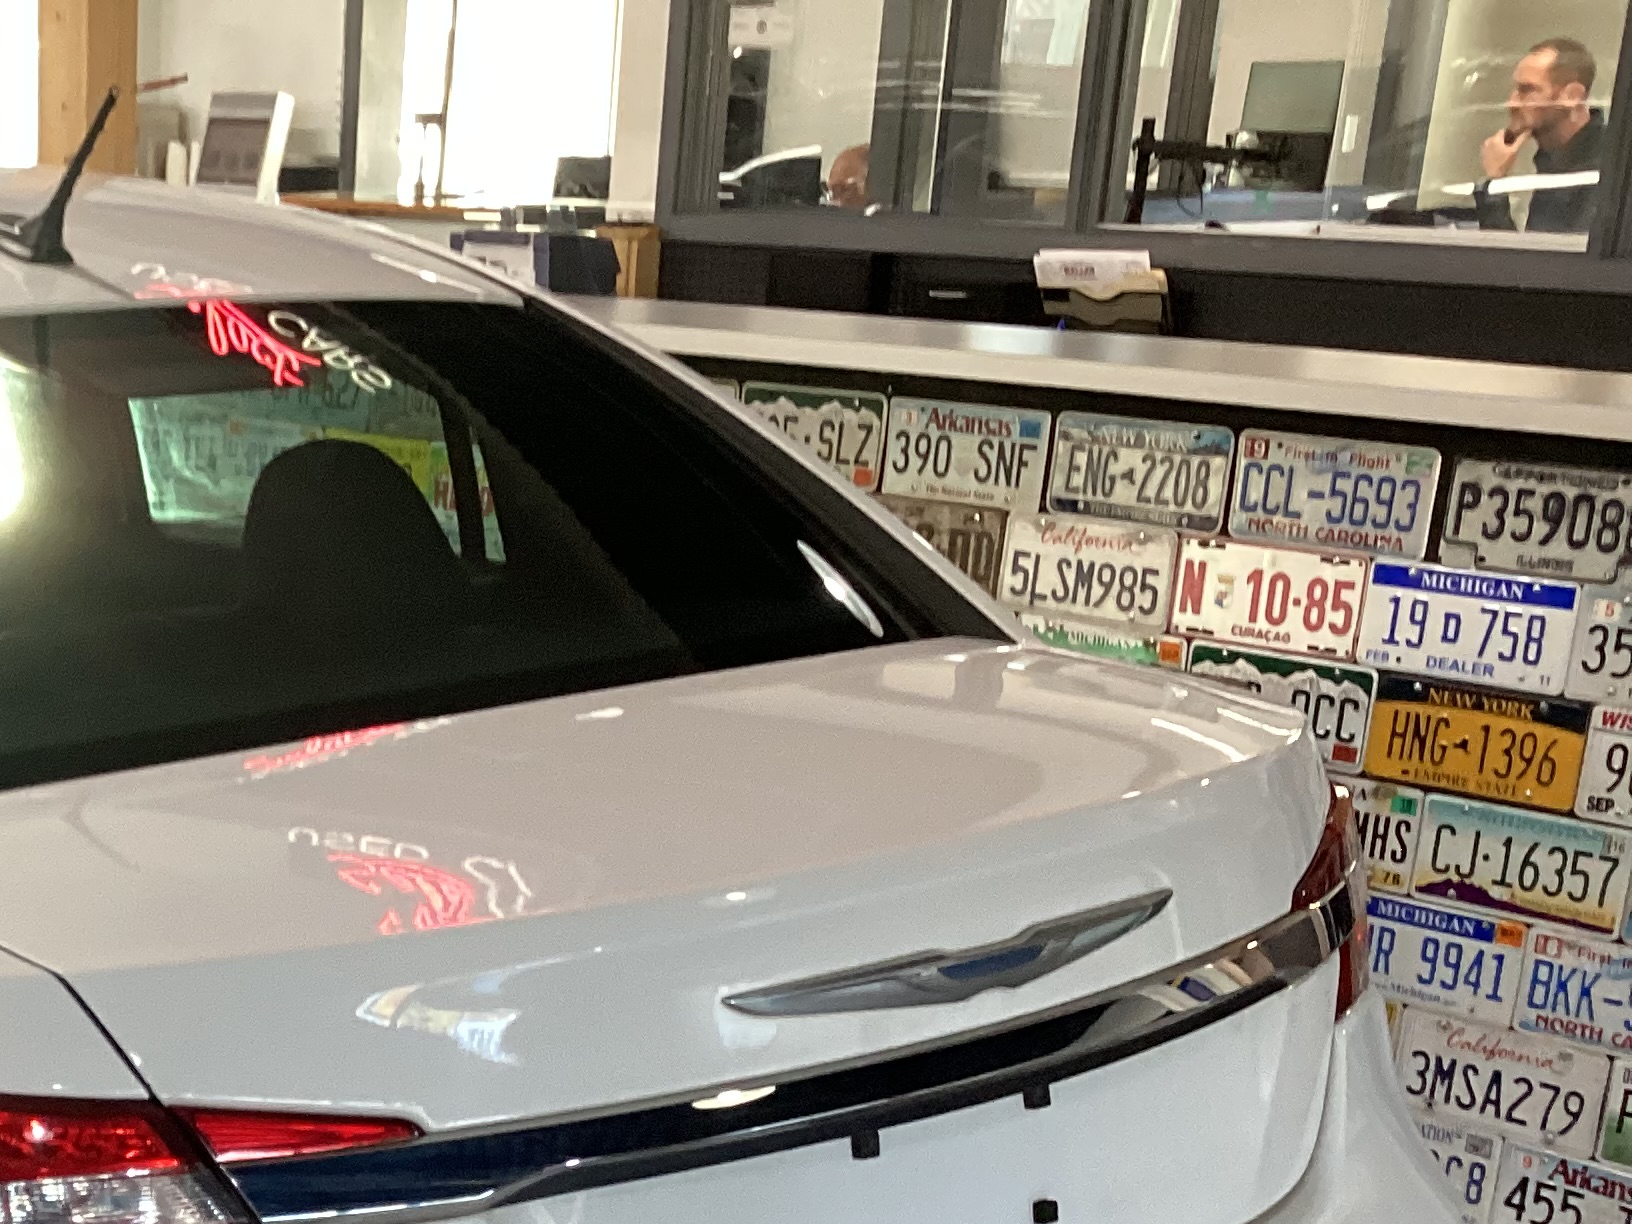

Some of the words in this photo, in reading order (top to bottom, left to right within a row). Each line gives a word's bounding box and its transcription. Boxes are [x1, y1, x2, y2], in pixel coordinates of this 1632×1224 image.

[925, 407, 1013, 438] Arkansas
[892, 429, 953, 478] 390
[973, 438, 1038, 488] SNF
[1065, 443, 1118, 498] ENG
[1136, 452, 1211, 509] 2208
[1239, 461, 1421, 533] CCL-5693
[1452, 480, 1632, 553] P35908
[1041, 521, 1134, 554] California
[1247, 517, 1308, 540] NORTH
[1315, 525, 1404, 552] CAROLINA
[1009, 549, 1160, 615] 5LSM985
[1516, 555, 1573, 572] ILLINOIS
[1179, 558, 1207, 615] N
[1420, 571, 1524, 600] MICHIGAN
[1231, 624, 1291, 644] CURAÇAO
[1381, 594, 1429, 649] 19
[1441, 611, 1462, 644] D
[1478, 606, 1546, 667] 758
[1426, 655, 1495, 678] DEALER
[1429, 688, 1477, 709] NEW
[1483, 696, 1534, 721] YORK
[1387, 709, 1451, 766] HNG
[1478, 724, 1559, 787] 1396
[1587, 795, 1615, 812] SEP
[1376, 898, 1476, 936] MICHIGAN
[1417, 936, 1506, 1003] 9941
[1536, 1013, 1604, 1043] NORTH
[1446, 1027, 1555, 1070] California
[1405, 1050, 1585, 1137] 3MSA279
